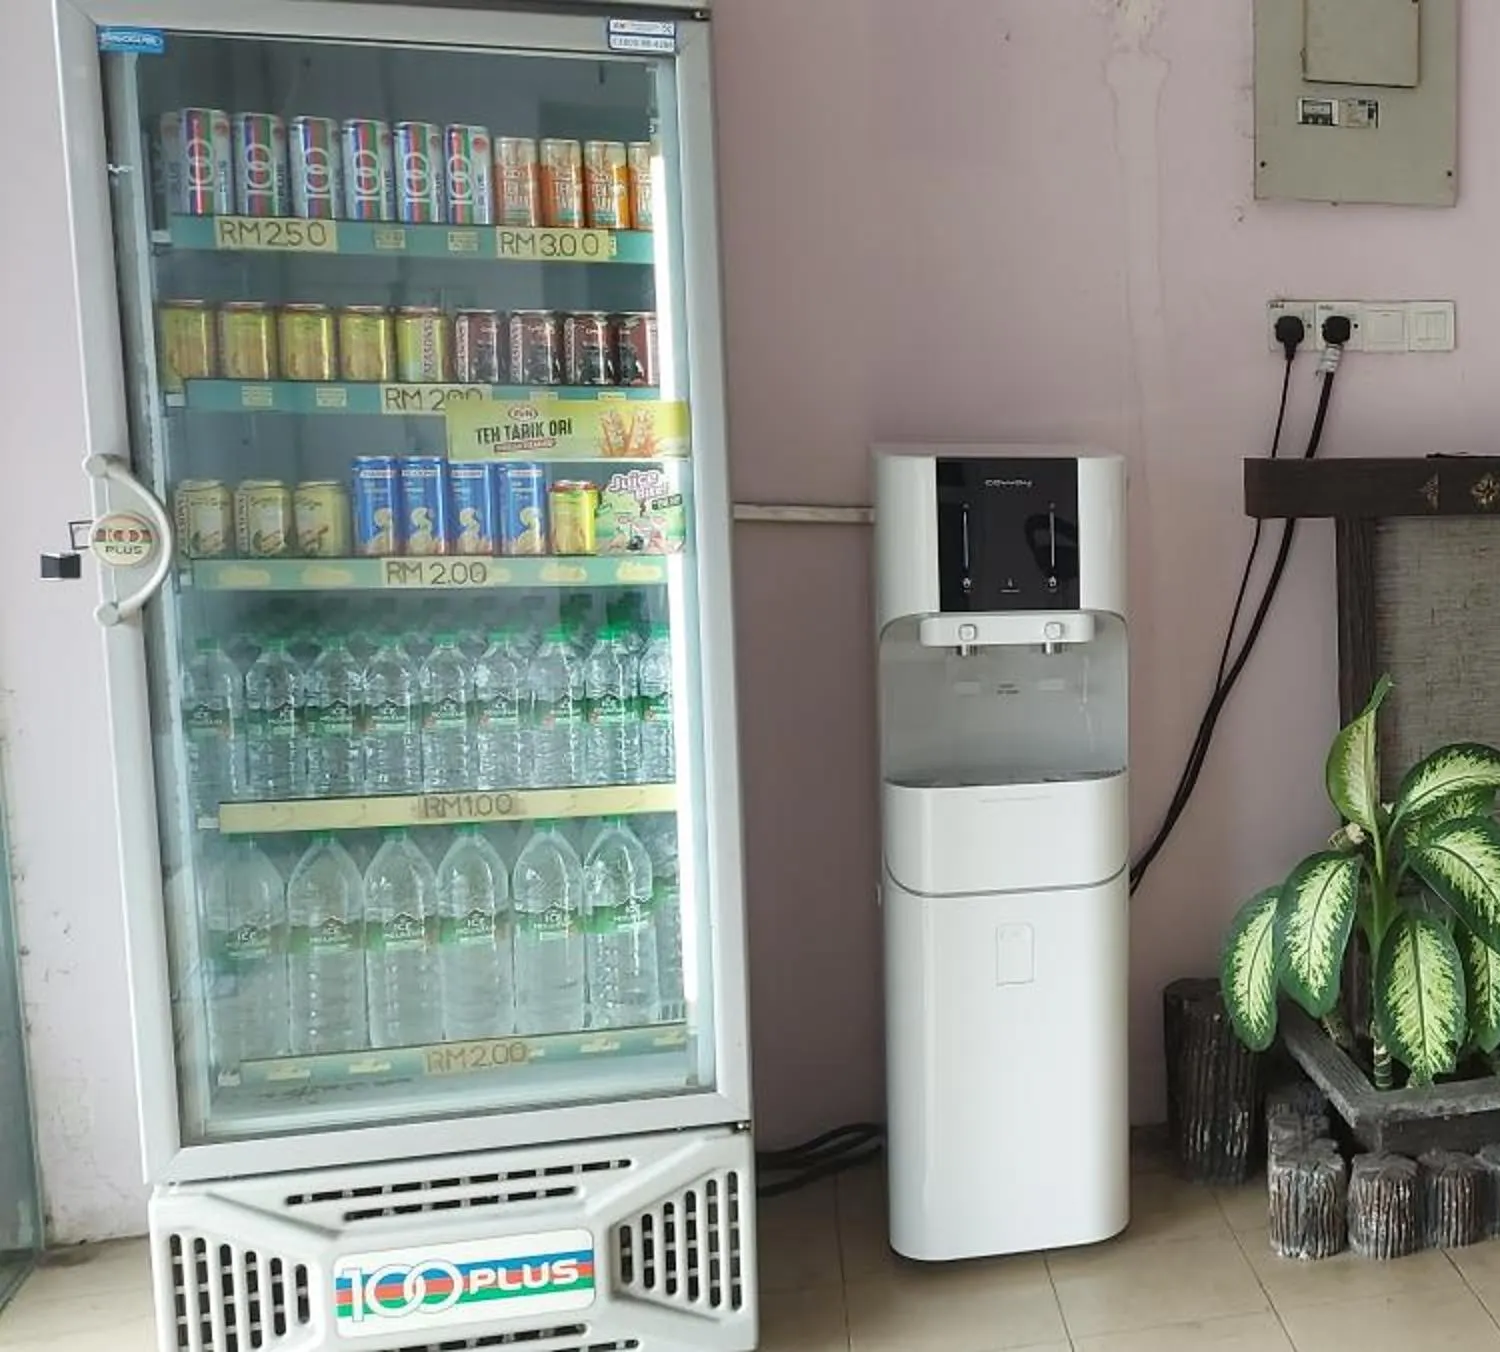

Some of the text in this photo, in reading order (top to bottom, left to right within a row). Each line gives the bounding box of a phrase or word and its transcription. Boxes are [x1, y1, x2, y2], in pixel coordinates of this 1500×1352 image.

[475, 425, 501, 445] TEH
[504, 421, 544, 441] TARIK
[549, 417, 573, 437] ORI
[105, 545, 143, 555] PLUS
[342, 1258, 580, 1323] 100 PLUS
